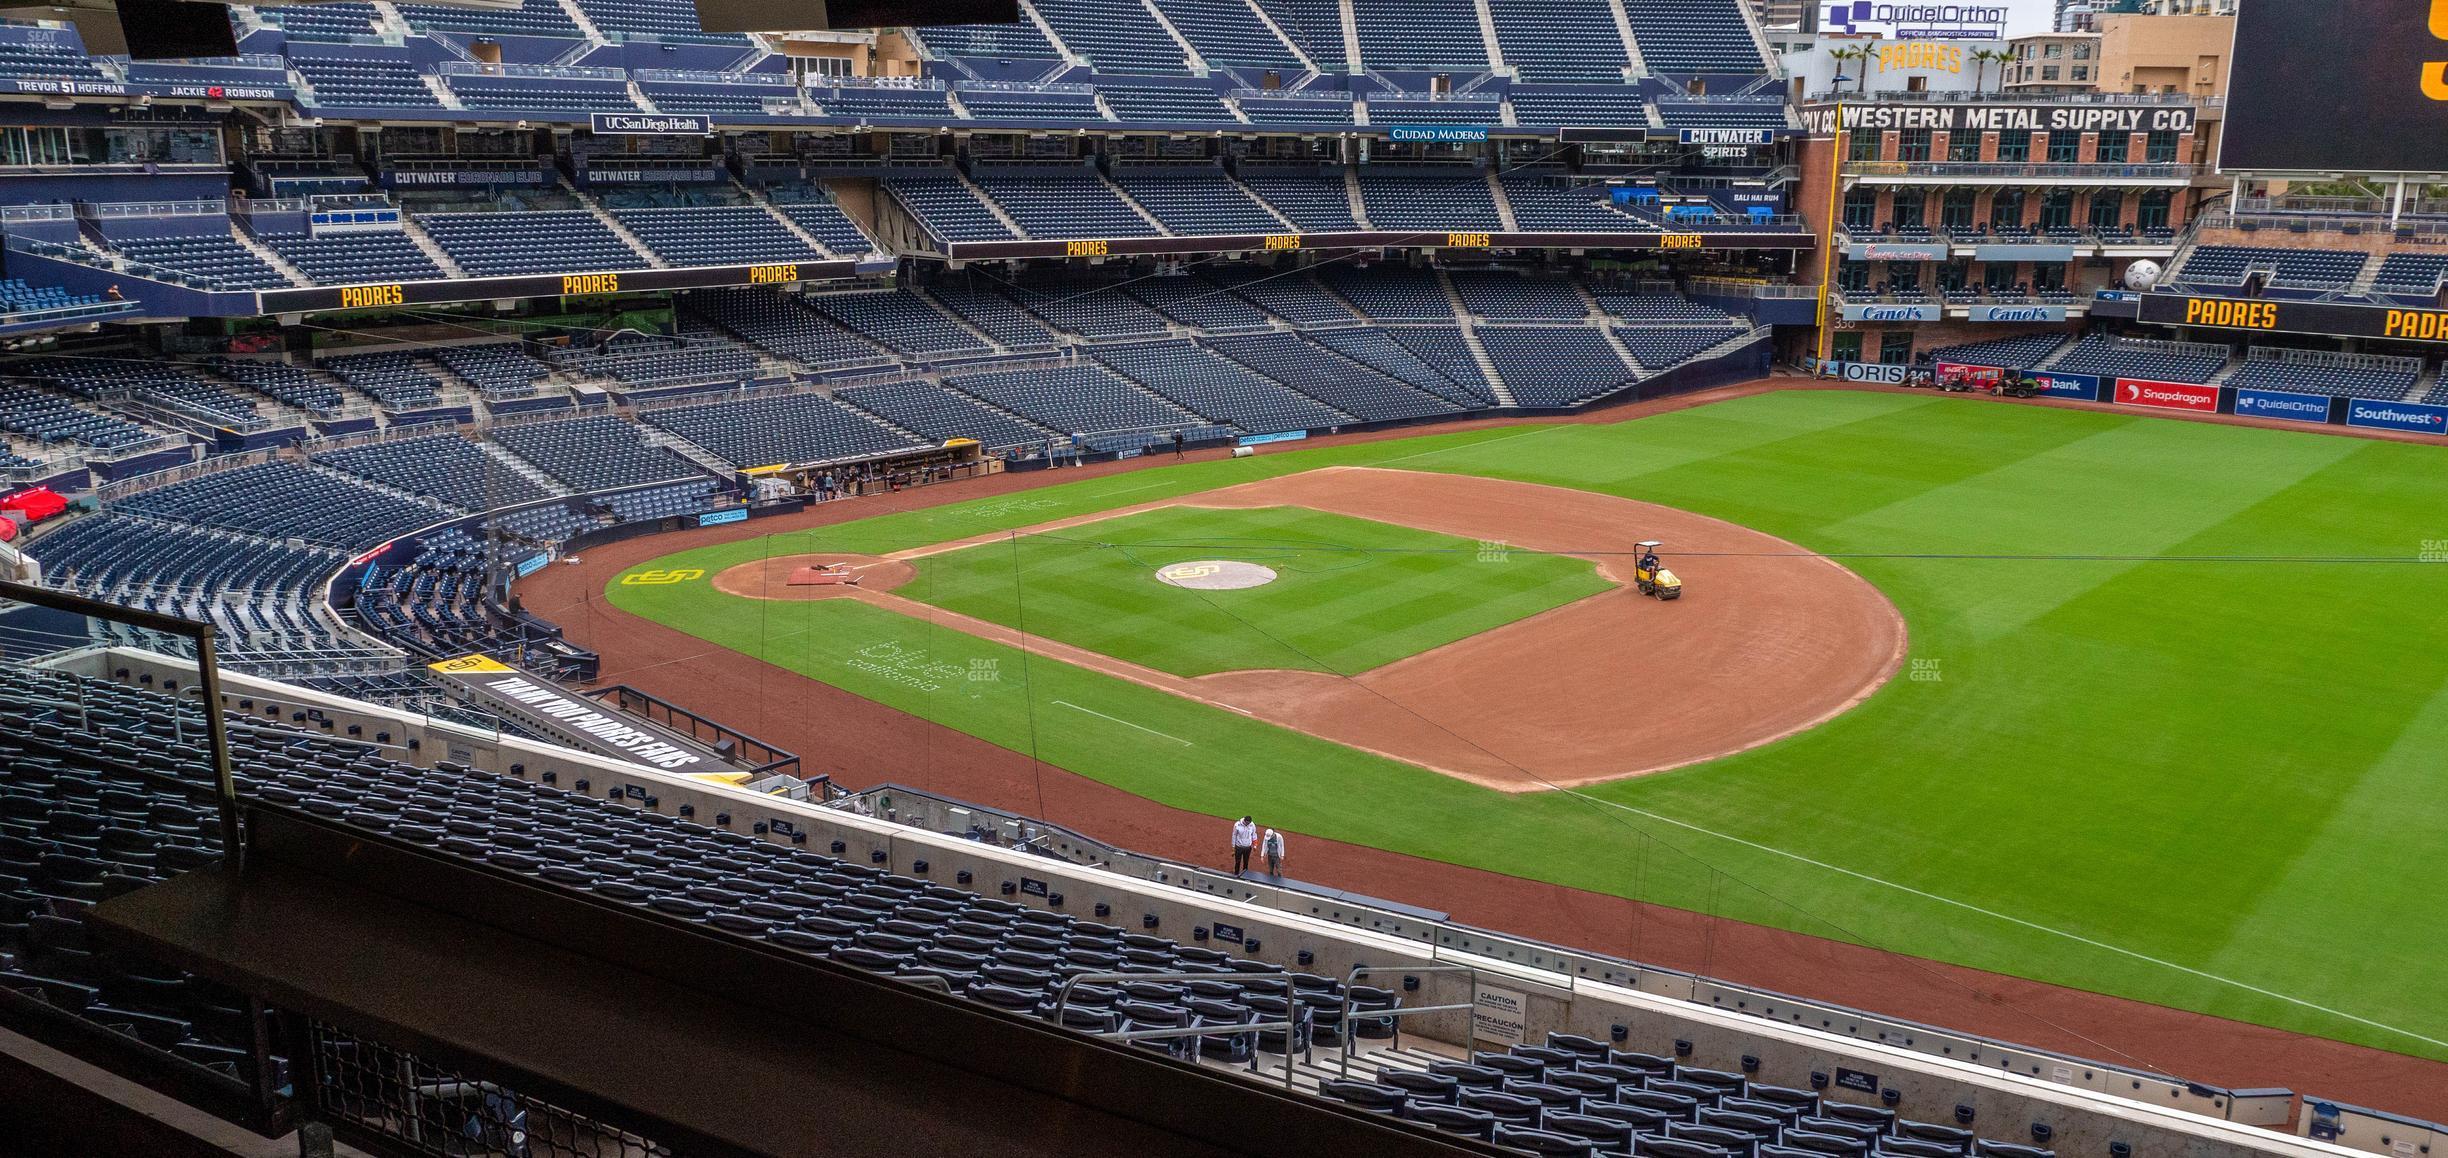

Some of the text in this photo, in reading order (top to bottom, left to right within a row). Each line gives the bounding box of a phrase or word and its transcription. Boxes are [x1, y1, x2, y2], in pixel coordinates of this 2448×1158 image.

[1877, 5, 2000, 25] QuidelOrtho
[1879, 42, 1962, 73] PADRES
[16, 81, 125, 94] TREVOR 51 HOFFMAN
[171, 86, 275, 98] JACKIE 42 ROBINSON
[604, 117, 699, 132] UC San Diego Health
[1842, 106, 2193, 132] WESTERN METAL SUPPLY CO.
[1393, 129, 1485, 140] CIUDAD MADERAS
[1690, 130, 1763, 143] CUTWATER
[1703, 146, 1748, 157] SPIRITS
[395, 172, 455, 184] CUTWATER
[516, 171, 543, 183] CLUB
[588, 170, 640, 181] CUTWATER
[1265, 235, 1300, 249] PADRES
[1448, 233, 1489, 247] PADRES
[1661, 234, 1702, 248] PADRES
[1067, 240, 1107, 256] PADRES
[750, 265, 798, 283] PADRES
[563, 274, 618, 294] PADRES
[341, 284, 403, 308] PADRES
[1862, 306, 1922, 321] Canel's
[1988, 306, 2048, 321] Canel's
[2186, 299, 2278, 329] PADRES
[1847, 364, 1903, 383] ORIS
[2052, 378, 2081, 391] bank
[2143, 388, 2211, 405] Snapdragon
[2257, 399, 2324, 413] QuidelOrtho
[2354, 407, 2431, 425] Southwest
[701, 514, 724, 524] petco
[485, 677, 700, 768] THANK YOU PADRES FANS
[1480, 992, 1517, 1006] CAUTION
